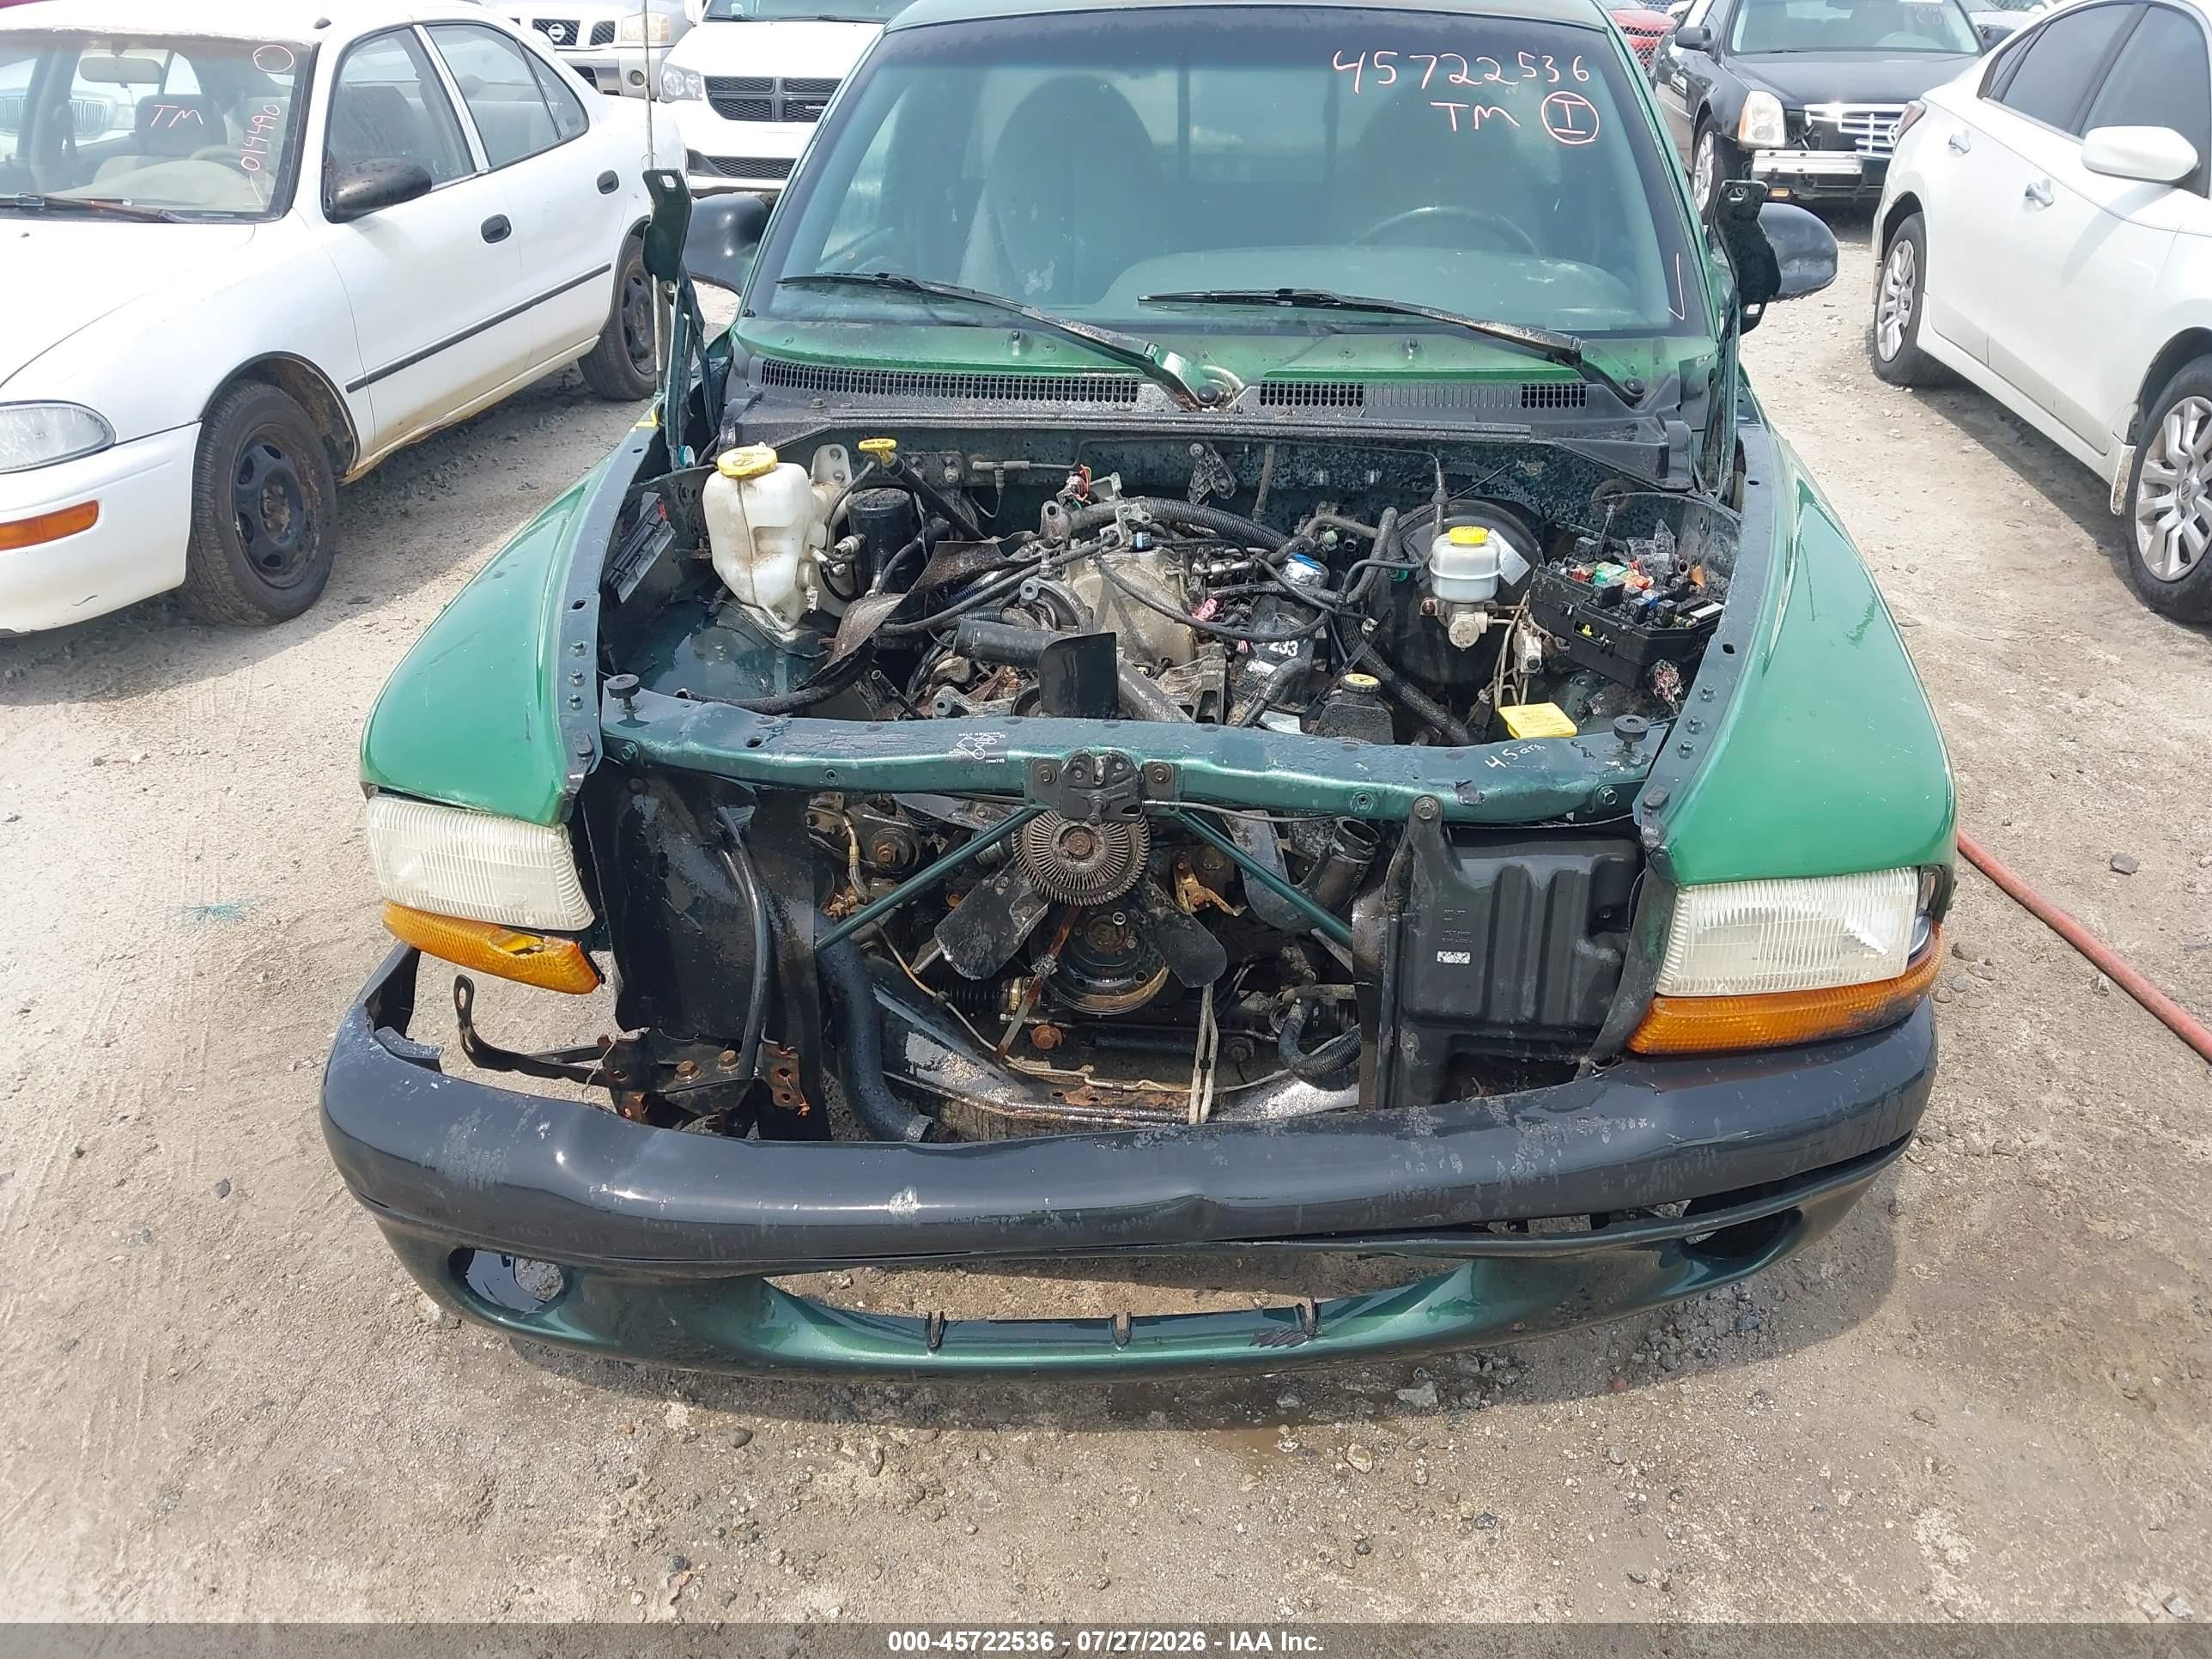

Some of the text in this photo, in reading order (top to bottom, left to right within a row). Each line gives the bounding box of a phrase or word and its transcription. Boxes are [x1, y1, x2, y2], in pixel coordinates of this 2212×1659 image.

[1333, 50, 1590, 94] 45722536
[150, 104, 204, 128] TM
[1429, 100, 1522, 131] TM
[240, 104, 281, 171] 014490
[1484, 748, 1518, 768] 4.5
